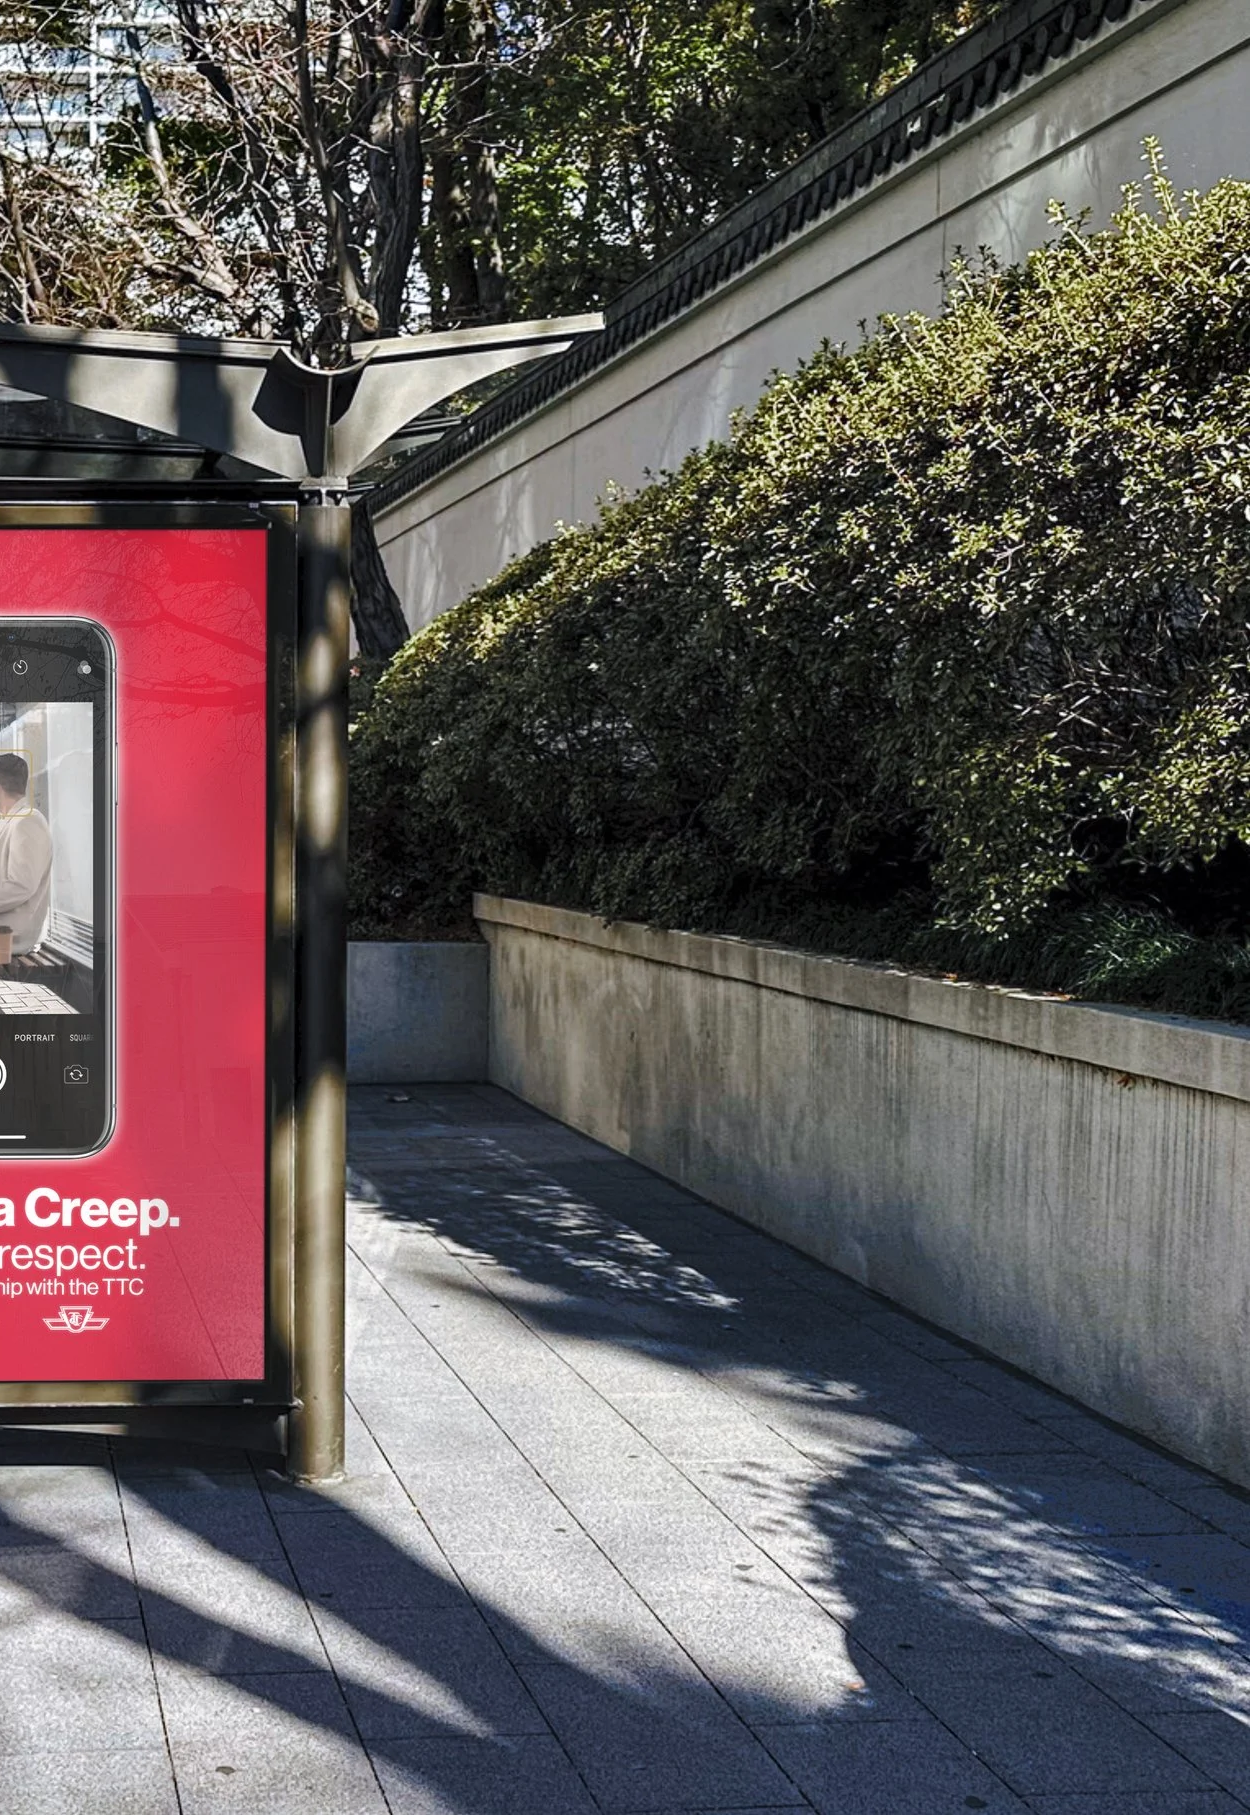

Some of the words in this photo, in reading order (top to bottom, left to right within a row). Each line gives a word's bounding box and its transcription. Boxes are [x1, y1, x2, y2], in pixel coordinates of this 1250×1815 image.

[14, 1033, 56, 1042] PORTRAIT
[24, 1187, 180, 1236] Creep.
[25, 1277, 65, 1296] with
[68, 1277, 99, 1296] the
[101, 1277, 144, 1296] TTC
